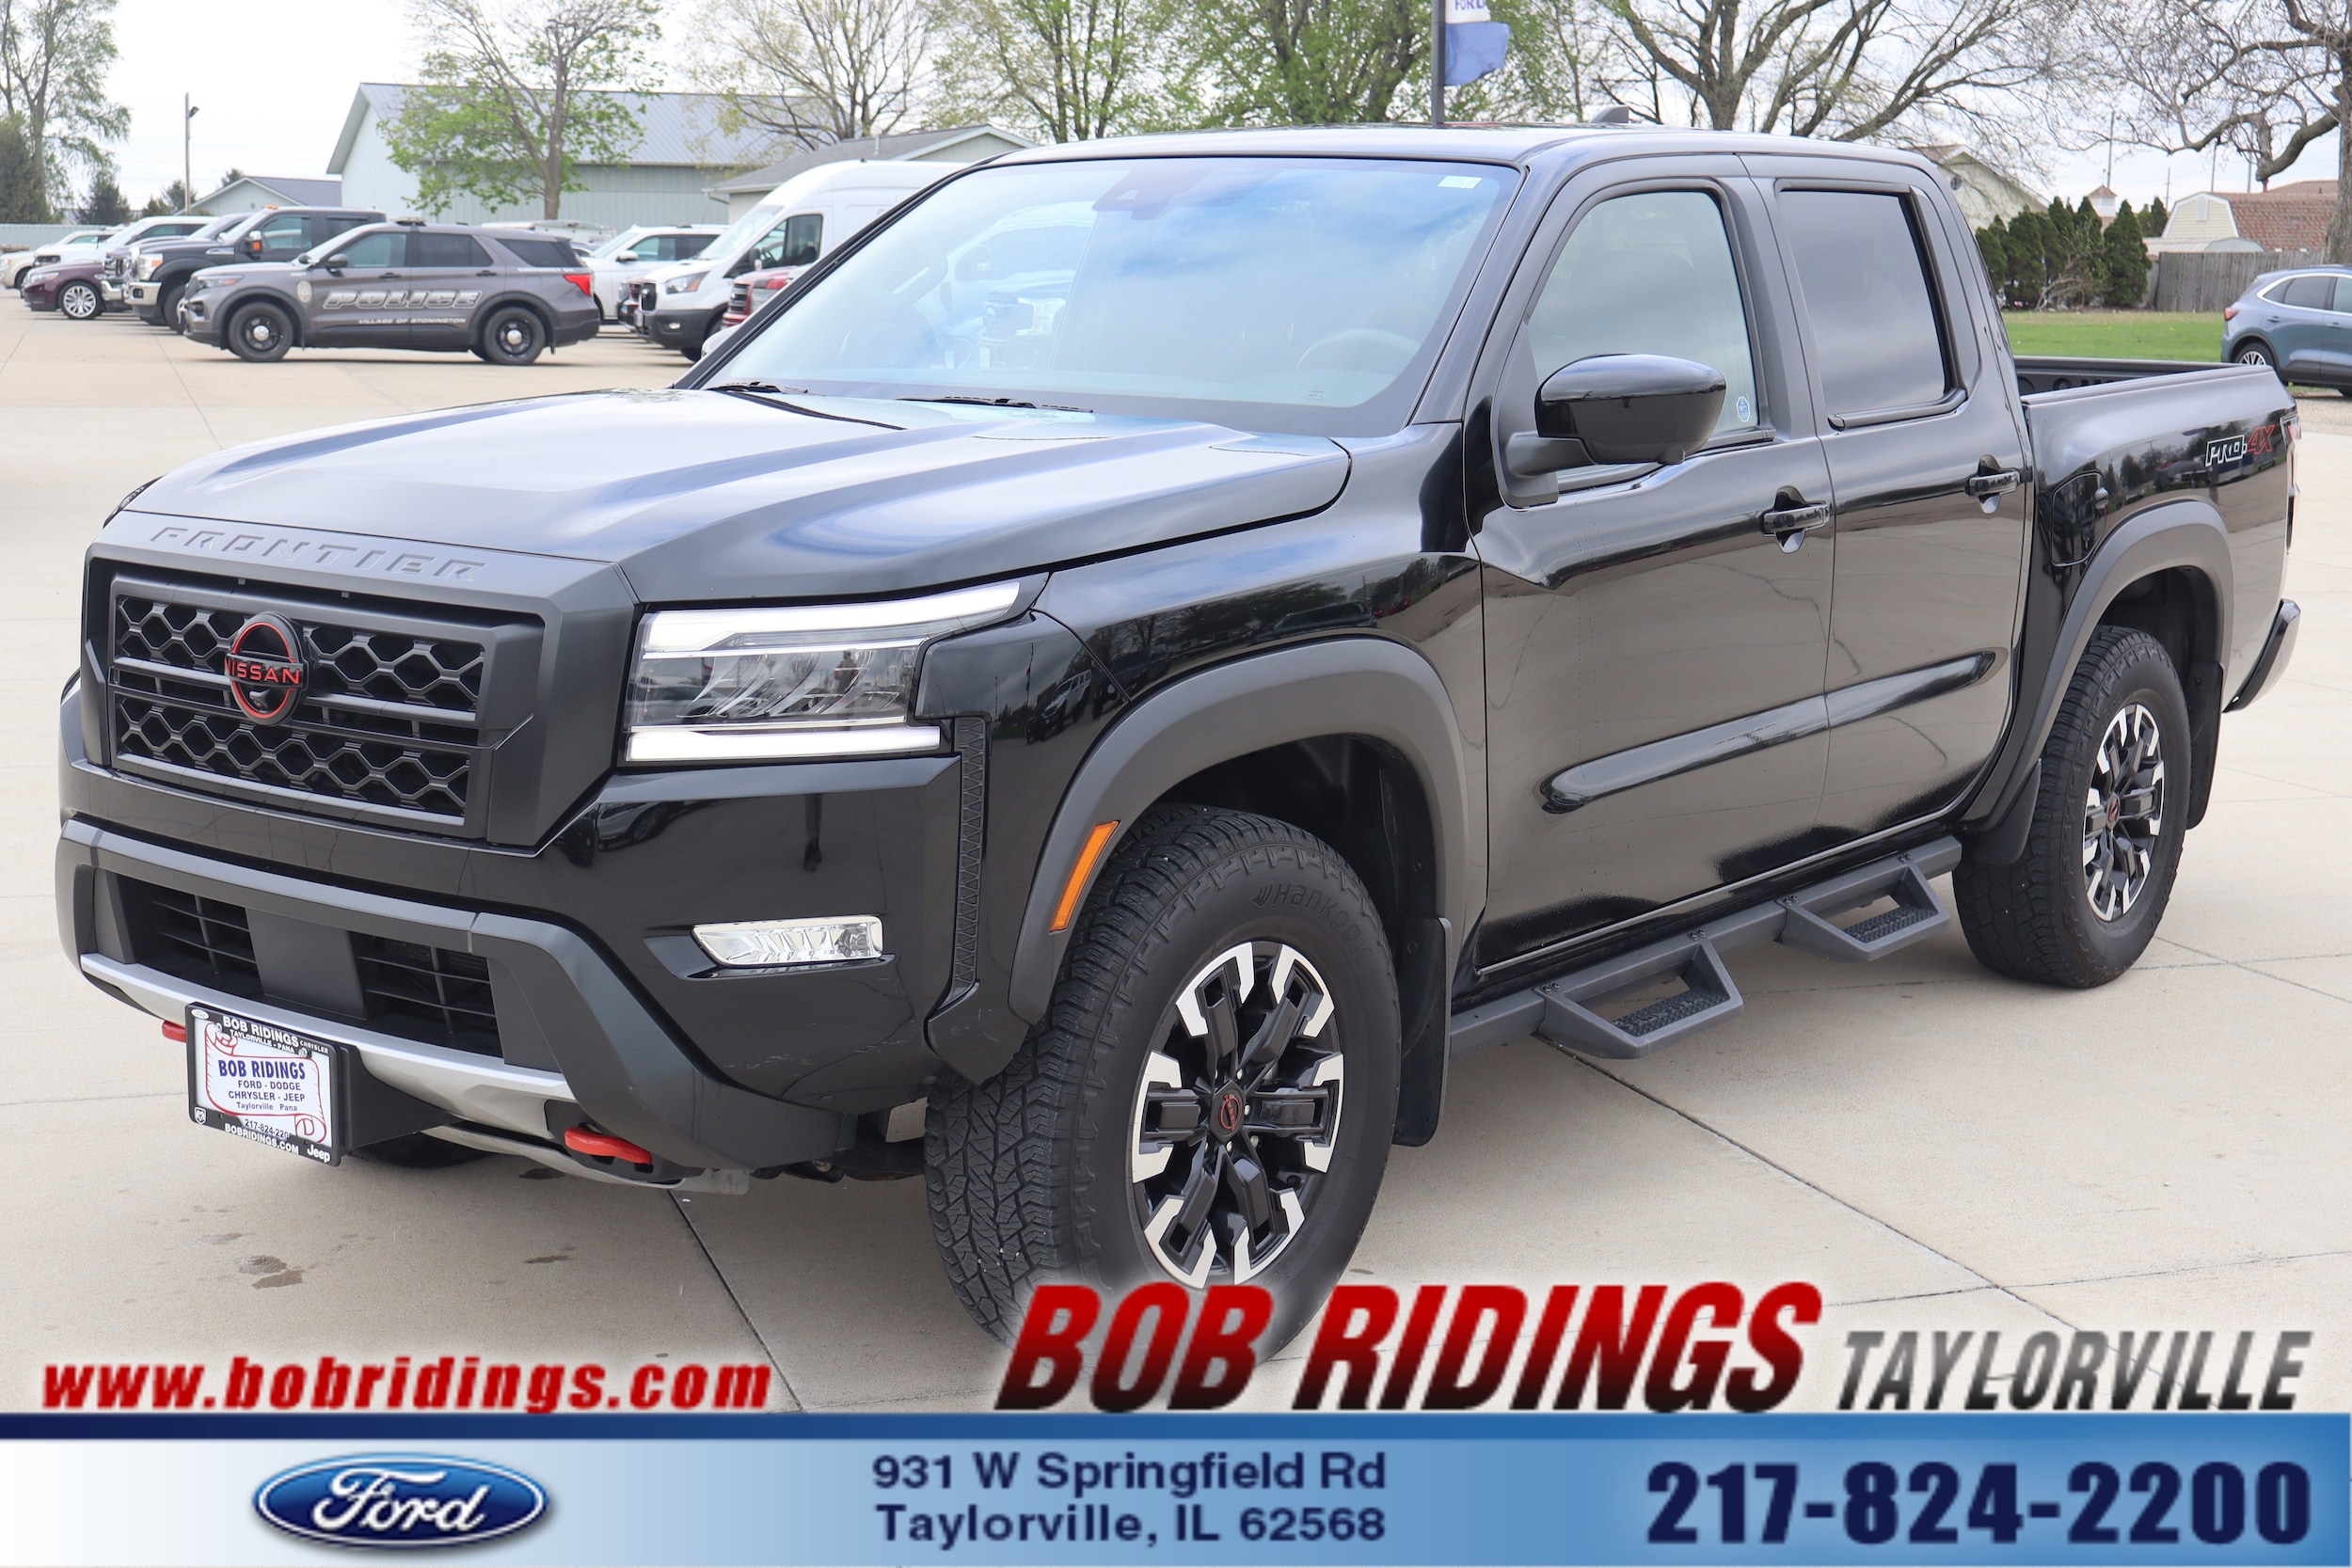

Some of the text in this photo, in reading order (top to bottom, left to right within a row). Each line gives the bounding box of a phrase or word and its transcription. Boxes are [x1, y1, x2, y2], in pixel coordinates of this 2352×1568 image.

[323, 289, 483, 309] POLICE
[150, 527, 486, 582] FRONTIER
[224, 657, 302, 685] NISSAN
[222, 1015, 299, 1048] BOB RIDINGS
[229, 1029, 273, 1047] TAYLORVILLE
[277, 1042, 295, 1053] PANA
[299, 1040, 329, 1054] CHRYSLER
[218, 1059, 306, 1080] BOB RIDINGS
[238, 1080, 262, 1089] FORD
[270, 1081, 301, 1091] DODGE
[228, 1090, 276, 1101] CHRYSLER
[283, 1092, 305, 1102] JEEP
[236, 1101, 297, 1112] Taylorville Pana
[224, 1123, 299, 1155] BOBRIDINGS.COM
[307, 1144, 331, 1163] Jeep
